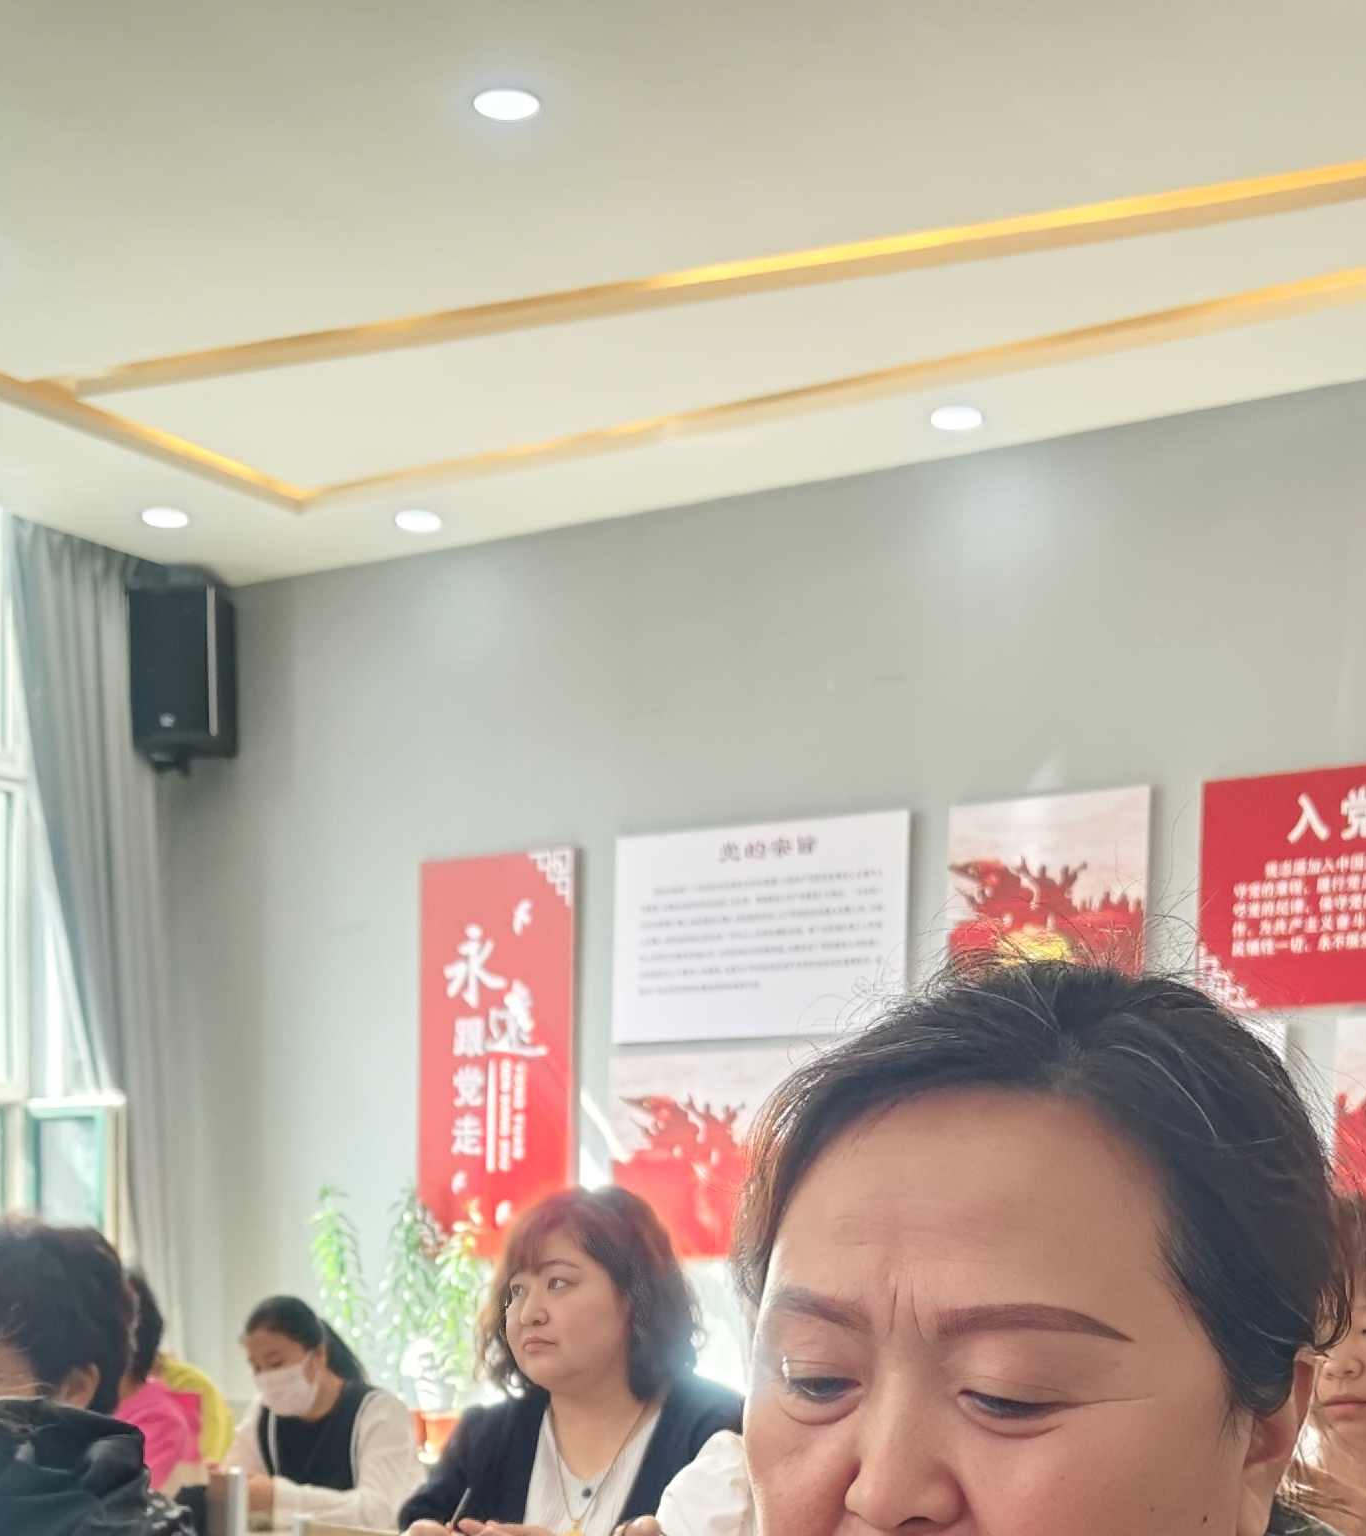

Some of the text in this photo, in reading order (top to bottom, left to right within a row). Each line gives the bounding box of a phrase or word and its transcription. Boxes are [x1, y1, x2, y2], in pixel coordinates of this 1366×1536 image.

[719, 835, 819, 863] 党的宗旨
[451, 1015, 485, 1156] 跟党走
